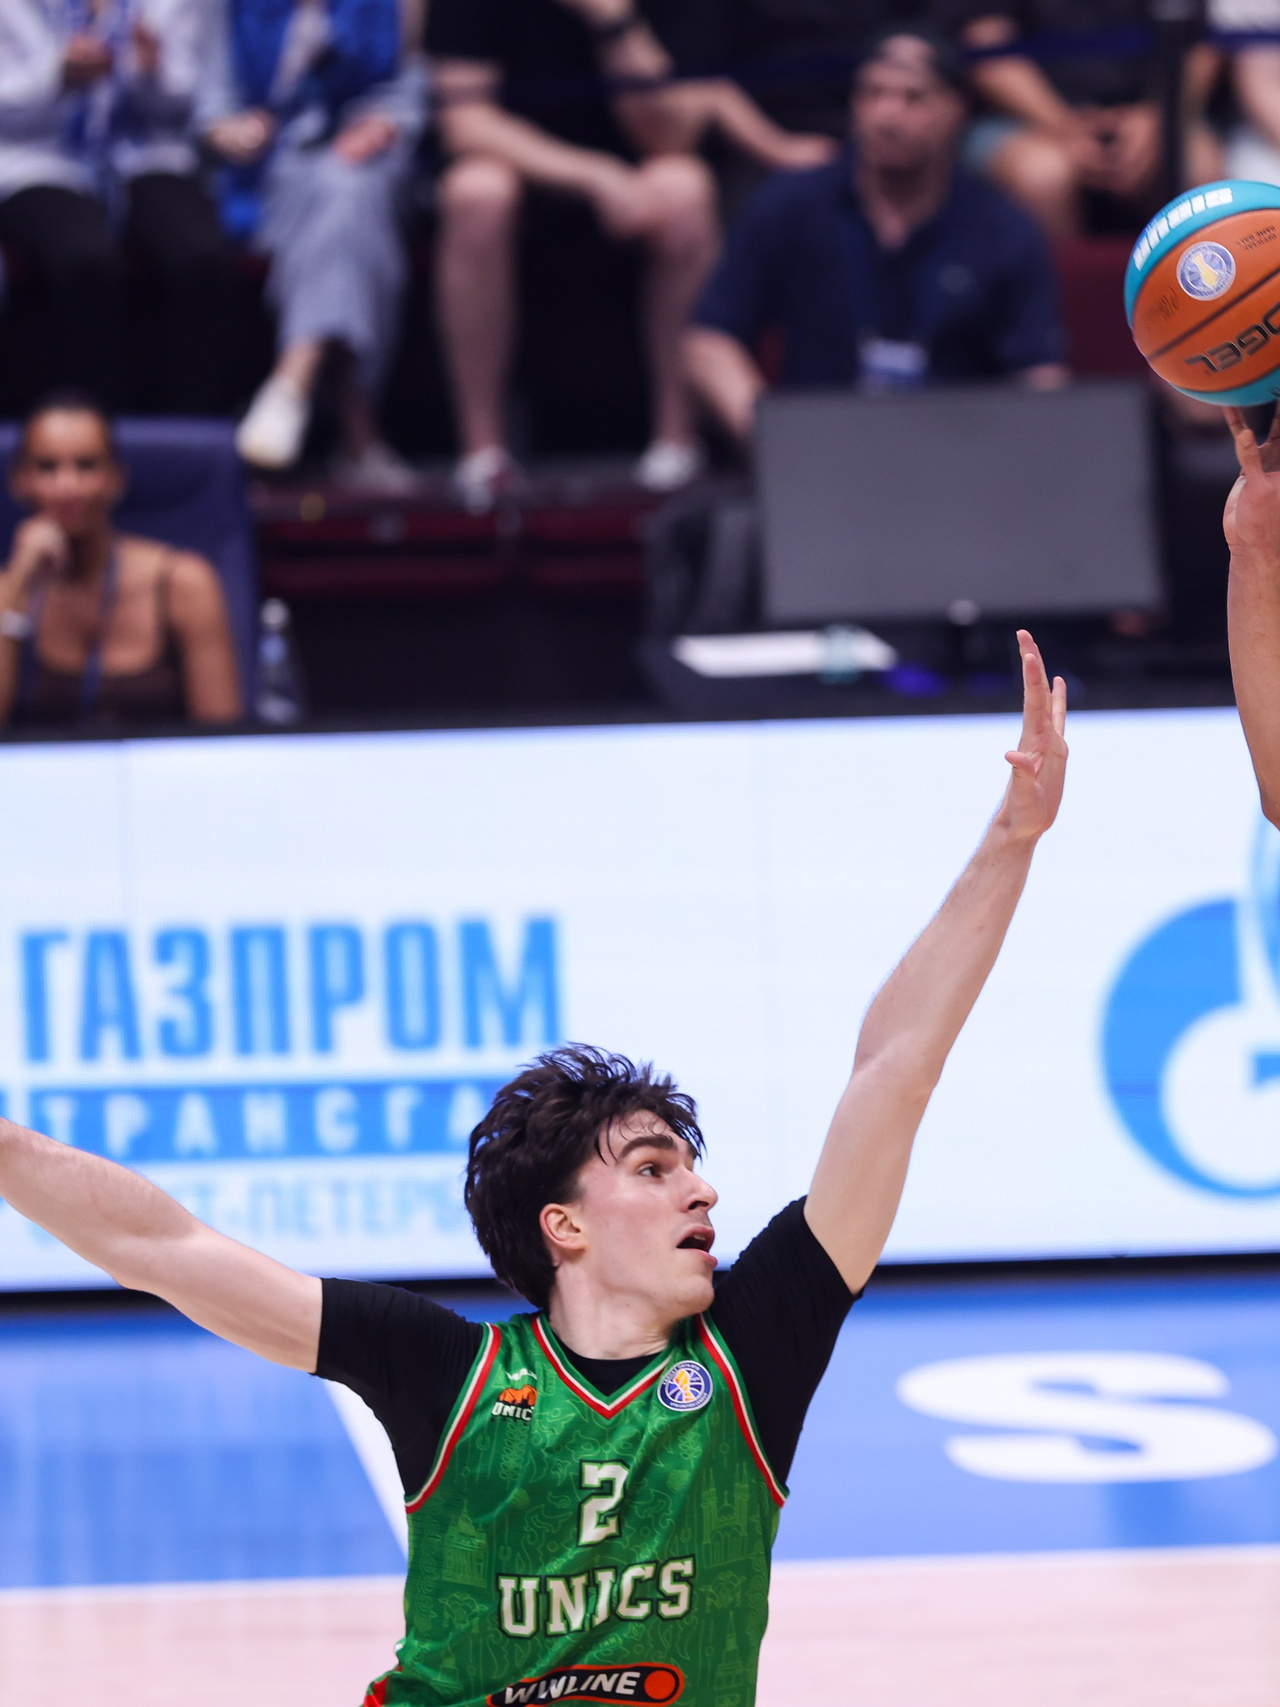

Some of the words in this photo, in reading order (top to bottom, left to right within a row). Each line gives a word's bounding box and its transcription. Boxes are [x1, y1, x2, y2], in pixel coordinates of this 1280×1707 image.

[20, 912, 563, 1064] ГАЗПРОМ
[42, 1083, 480, 1158] ТРАНСГА
[491, 1401, 534, 1422] UNIC
[577, 1459, 630, 1547] 2
[498, 1556, 695, 1639] UNICS
